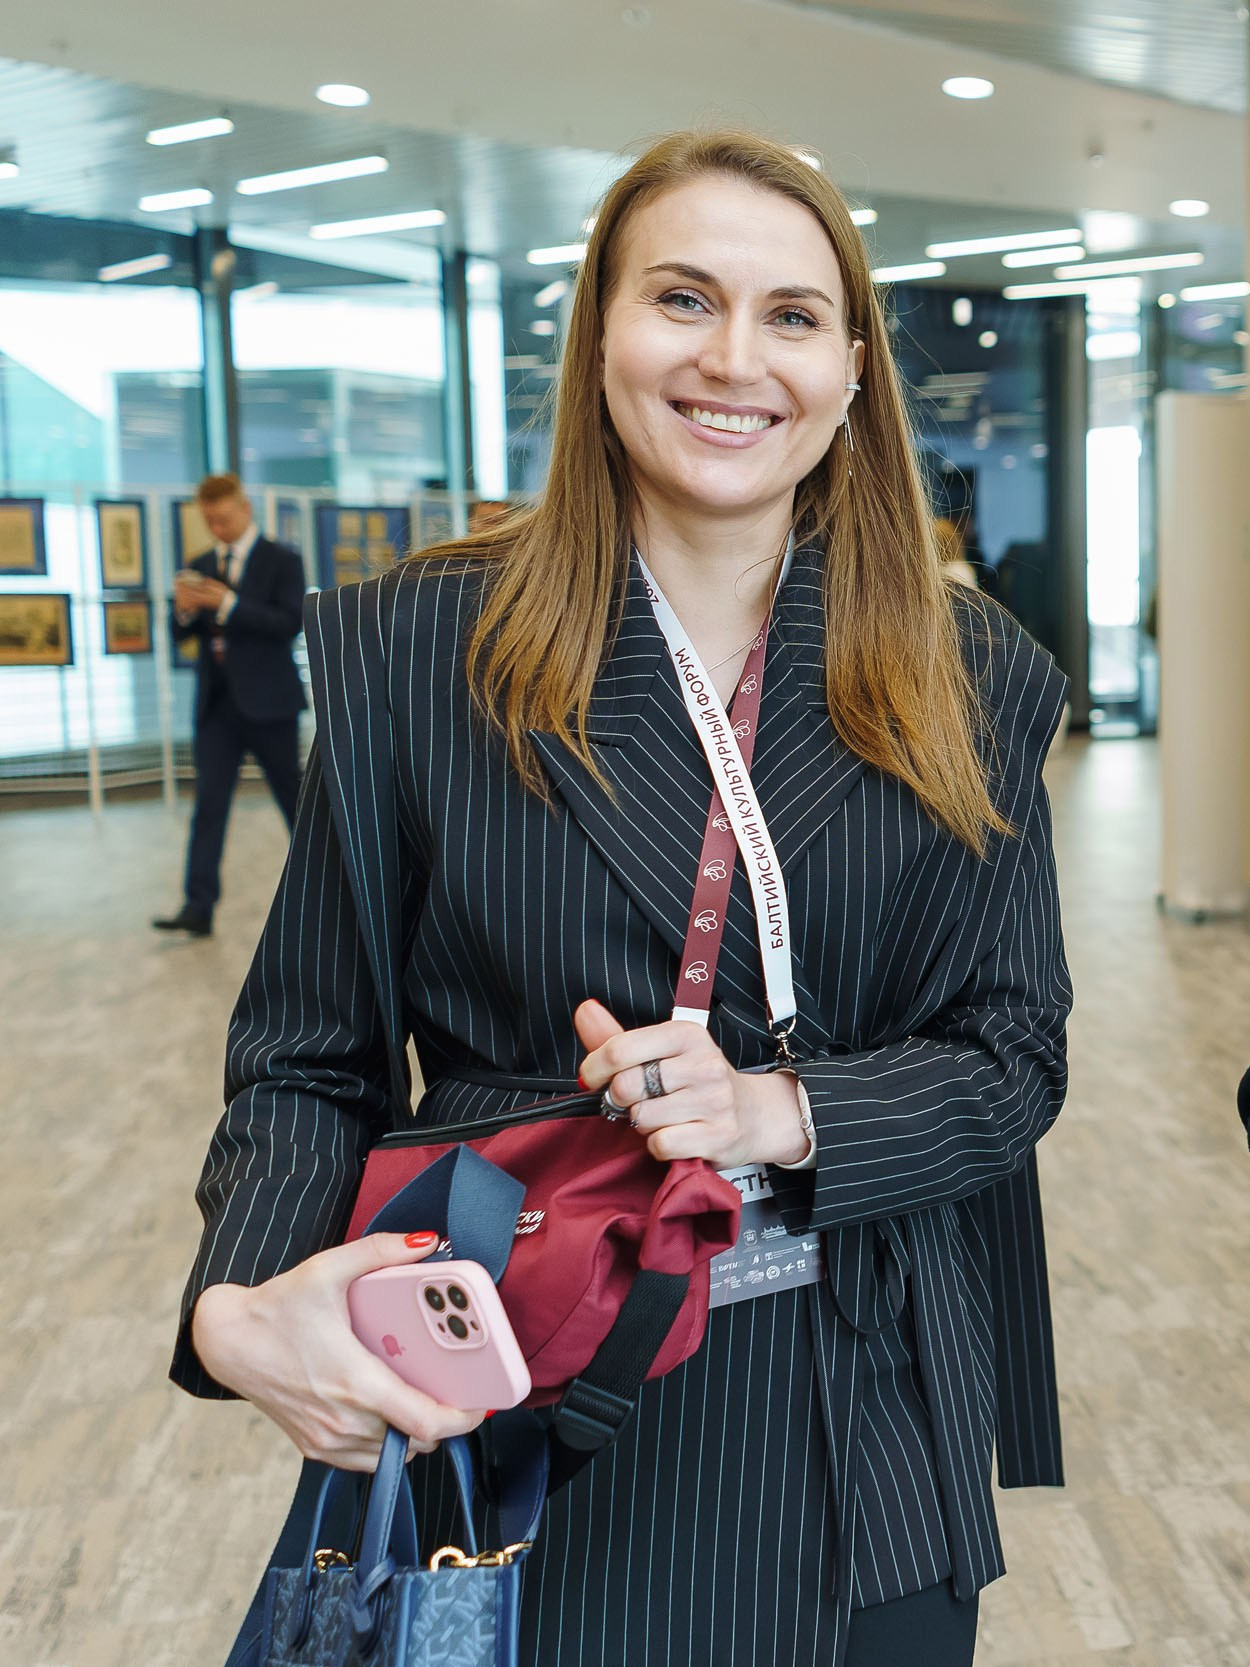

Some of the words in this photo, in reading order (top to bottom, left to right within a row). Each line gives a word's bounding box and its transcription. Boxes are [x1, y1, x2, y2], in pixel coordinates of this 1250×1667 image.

[674, 647, 710, 706] ФОРУМ
[699, 708, 754, 819] КУЛЬТУРНЫЙ
[742, 822, 784, 950] БАЛТИЙСКИЙ
